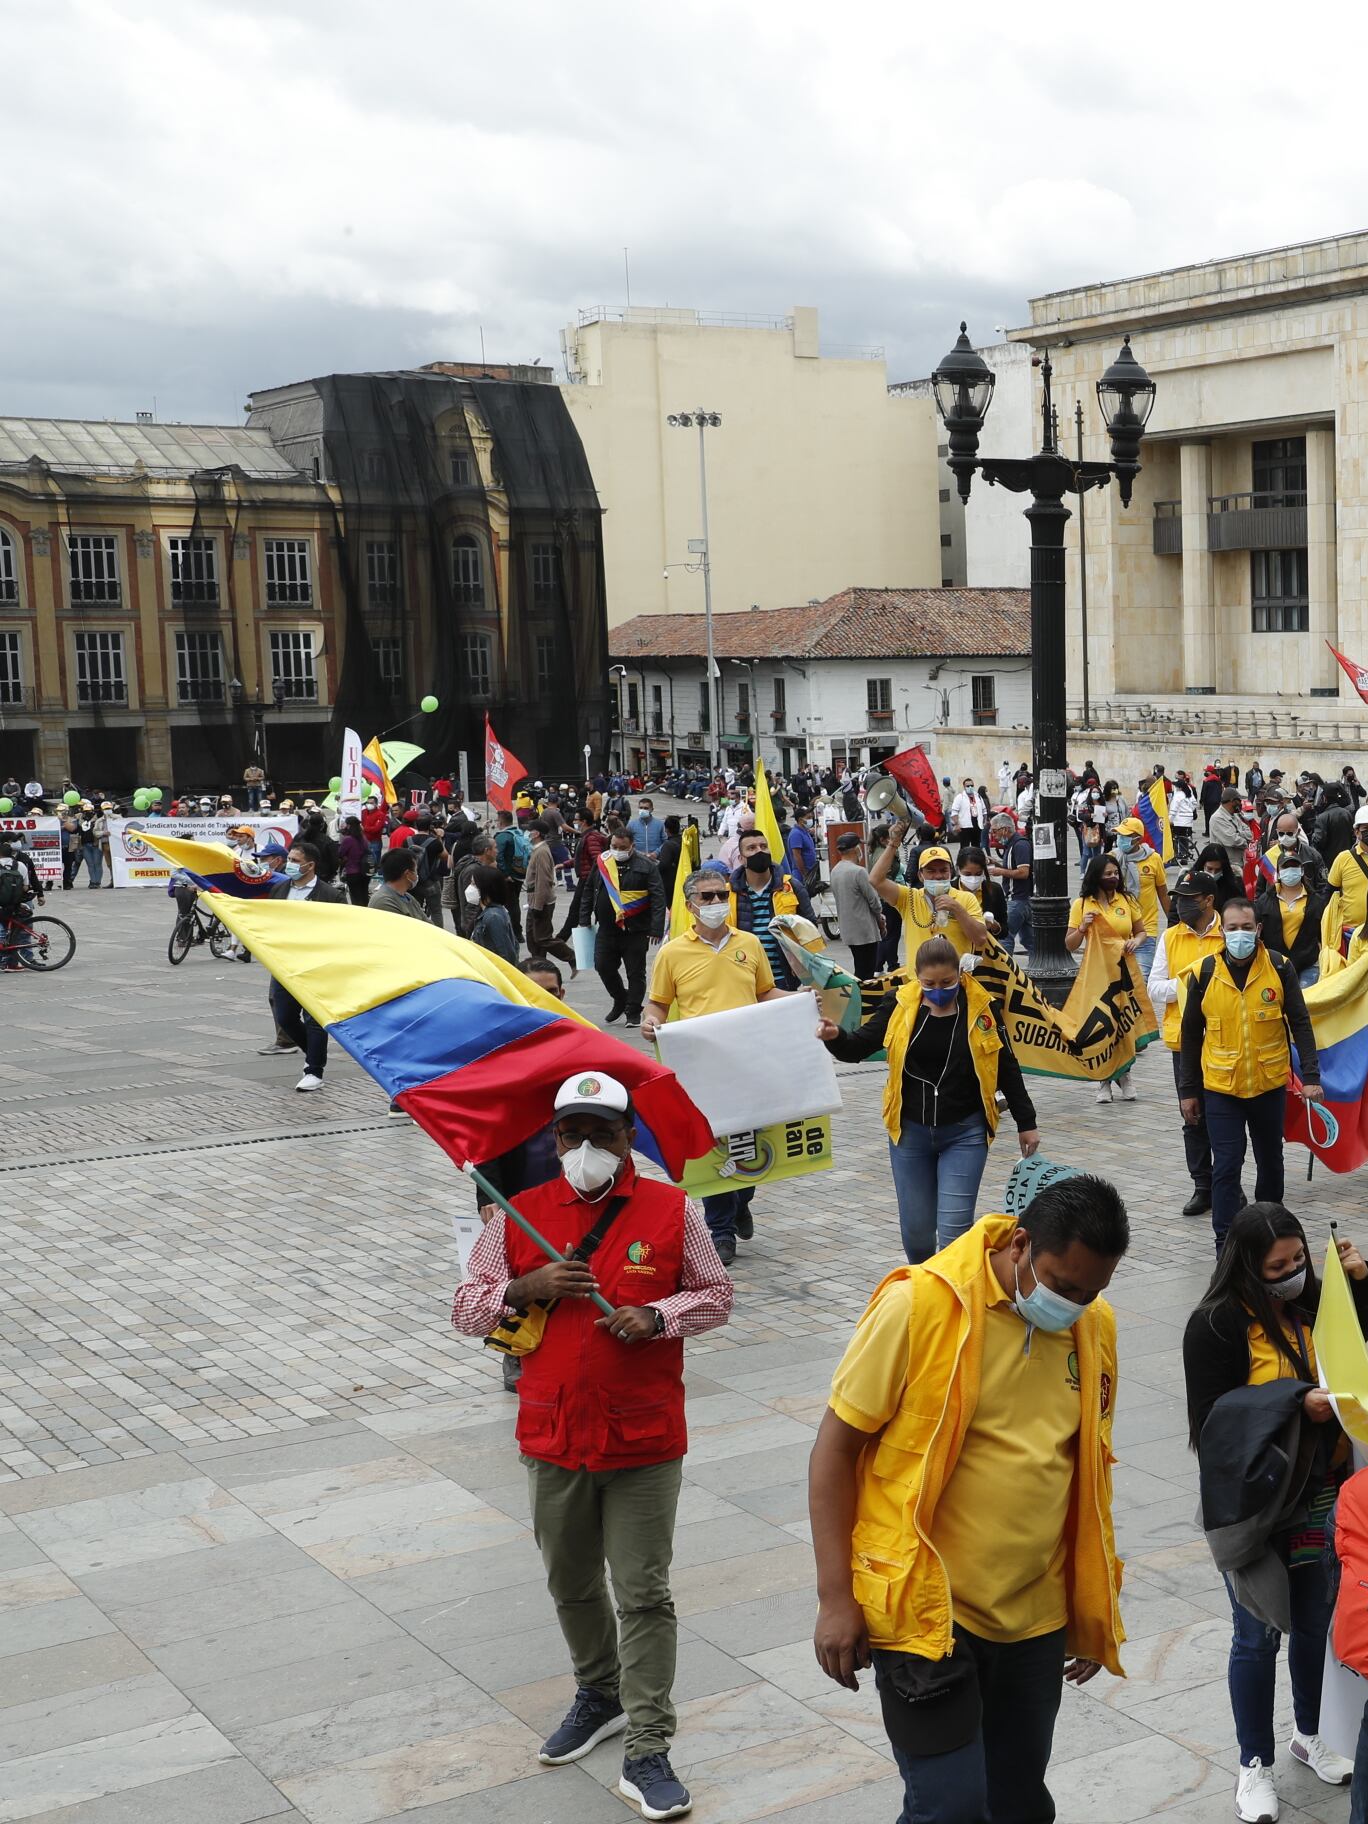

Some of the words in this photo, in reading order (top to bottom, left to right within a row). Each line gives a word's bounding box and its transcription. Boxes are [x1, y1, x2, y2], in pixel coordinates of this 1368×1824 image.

[0, 819, 37, 831] TAS
[146, 821, 177, 829] Sindicato
[134, 869, 171, 877] PRESENTE
